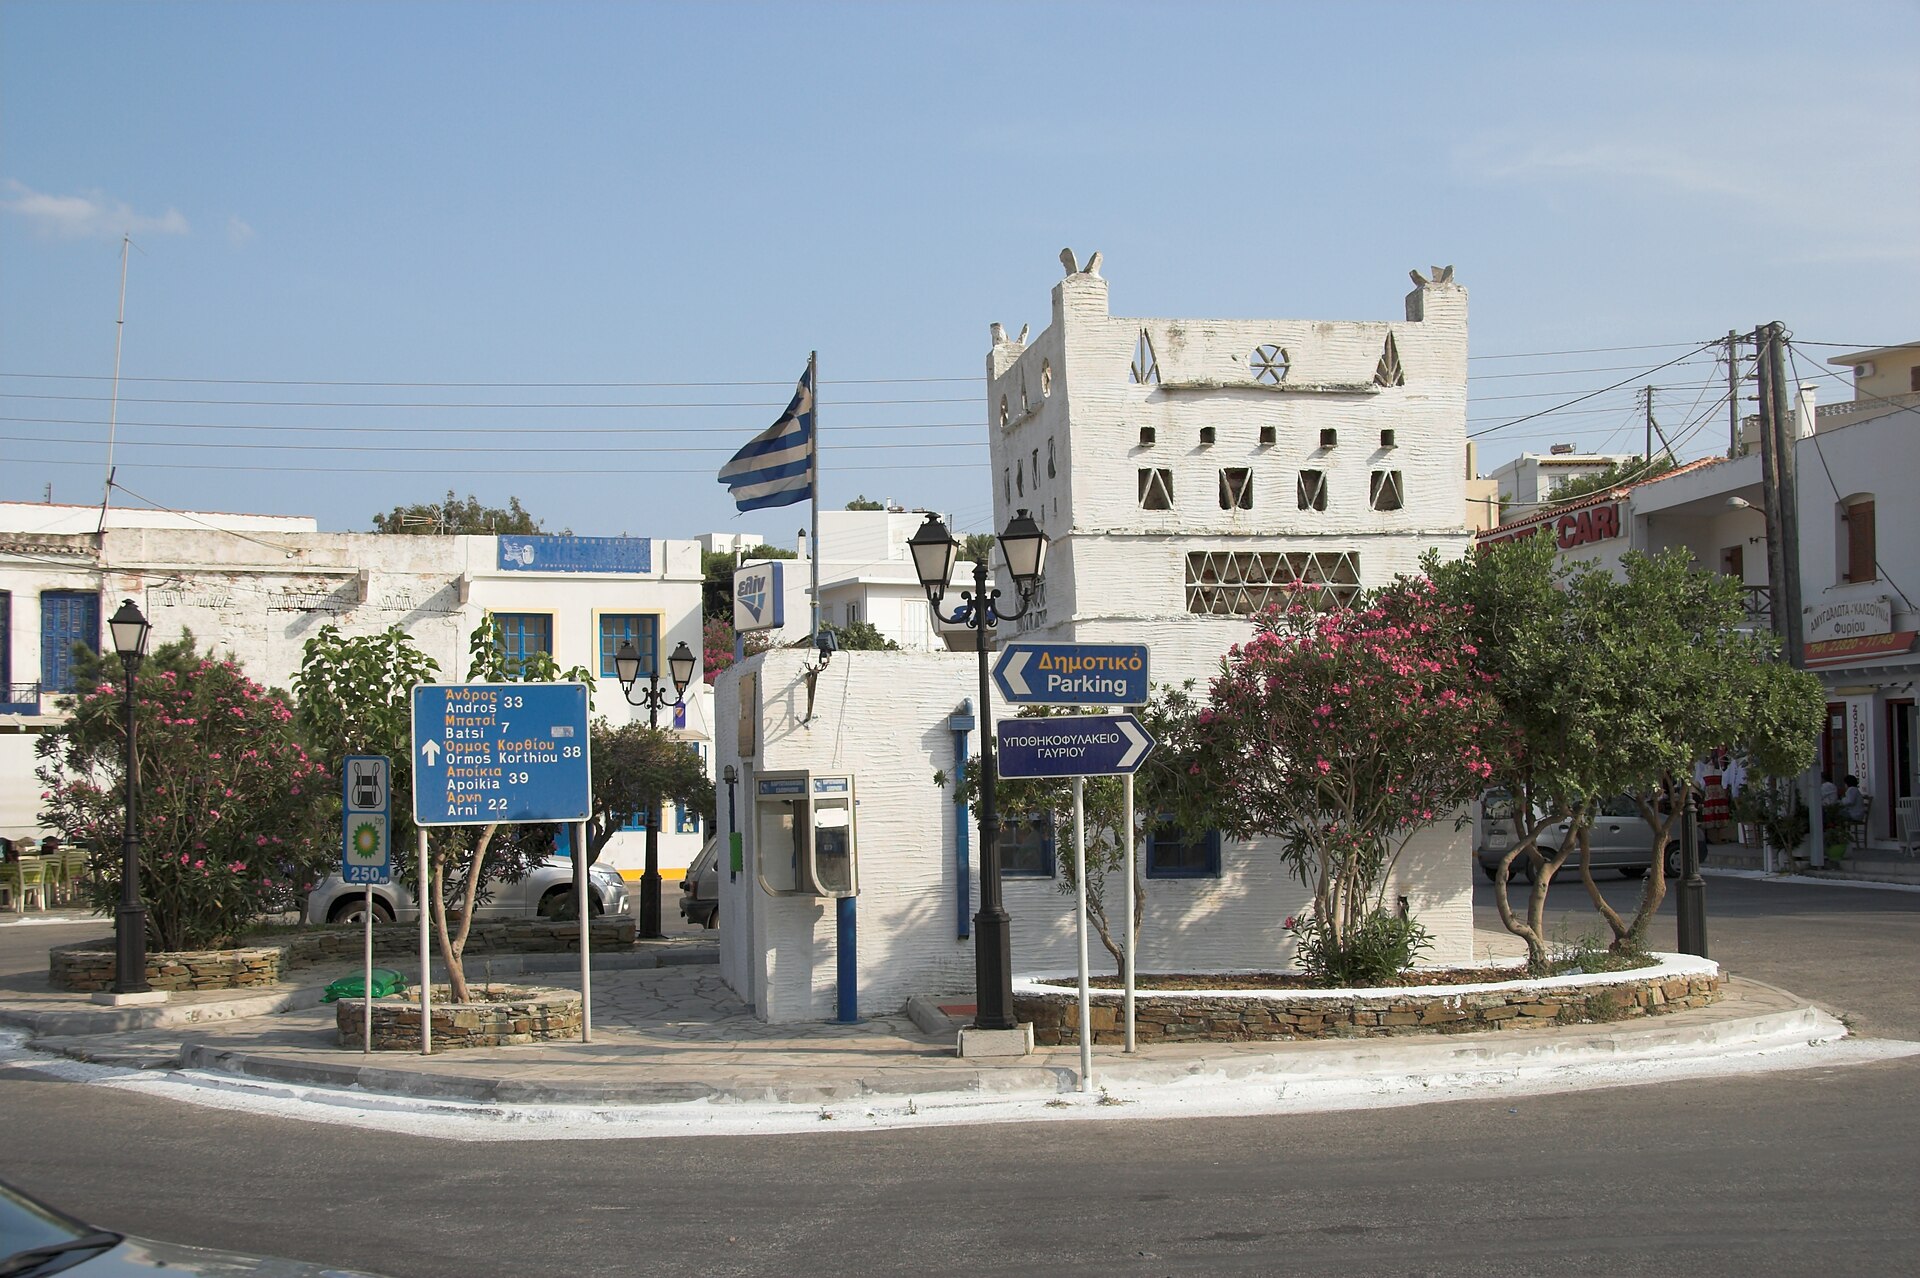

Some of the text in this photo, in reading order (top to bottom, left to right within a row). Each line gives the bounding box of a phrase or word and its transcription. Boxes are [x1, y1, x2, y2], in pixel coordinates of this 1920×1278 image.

[1038, 652, 1142, 673] Δημοτικό
[1048, 674, 1127, 697] Parking
[445, 688, 497, 703] Άνδρος
[446, 696, 524, 713] Andros 33
[445, 714, 496, 726] Μπατσί
[445, 722, 510, 739] Batsi 7
[443, 737, 555, 753] Όρμος Κορθίου
[1003, 733, 1120, 748] ΥΠΟΘΗΚΟΦΥΛΑΚΕΙΟ
[446, 746, 582, 765] Ormos Korthiou 38
[1037, 746, 1086, 759] ΓΑΥΡΙΟΥ
[447, 765, 502, 778] Αποίκια
[447, 772, 529, 792] Apoikia 39
[446, 790, 482, 804] Άρνη
[447, 798, 508, 816] Arni 22
[375, 816, 385, 827] bp
